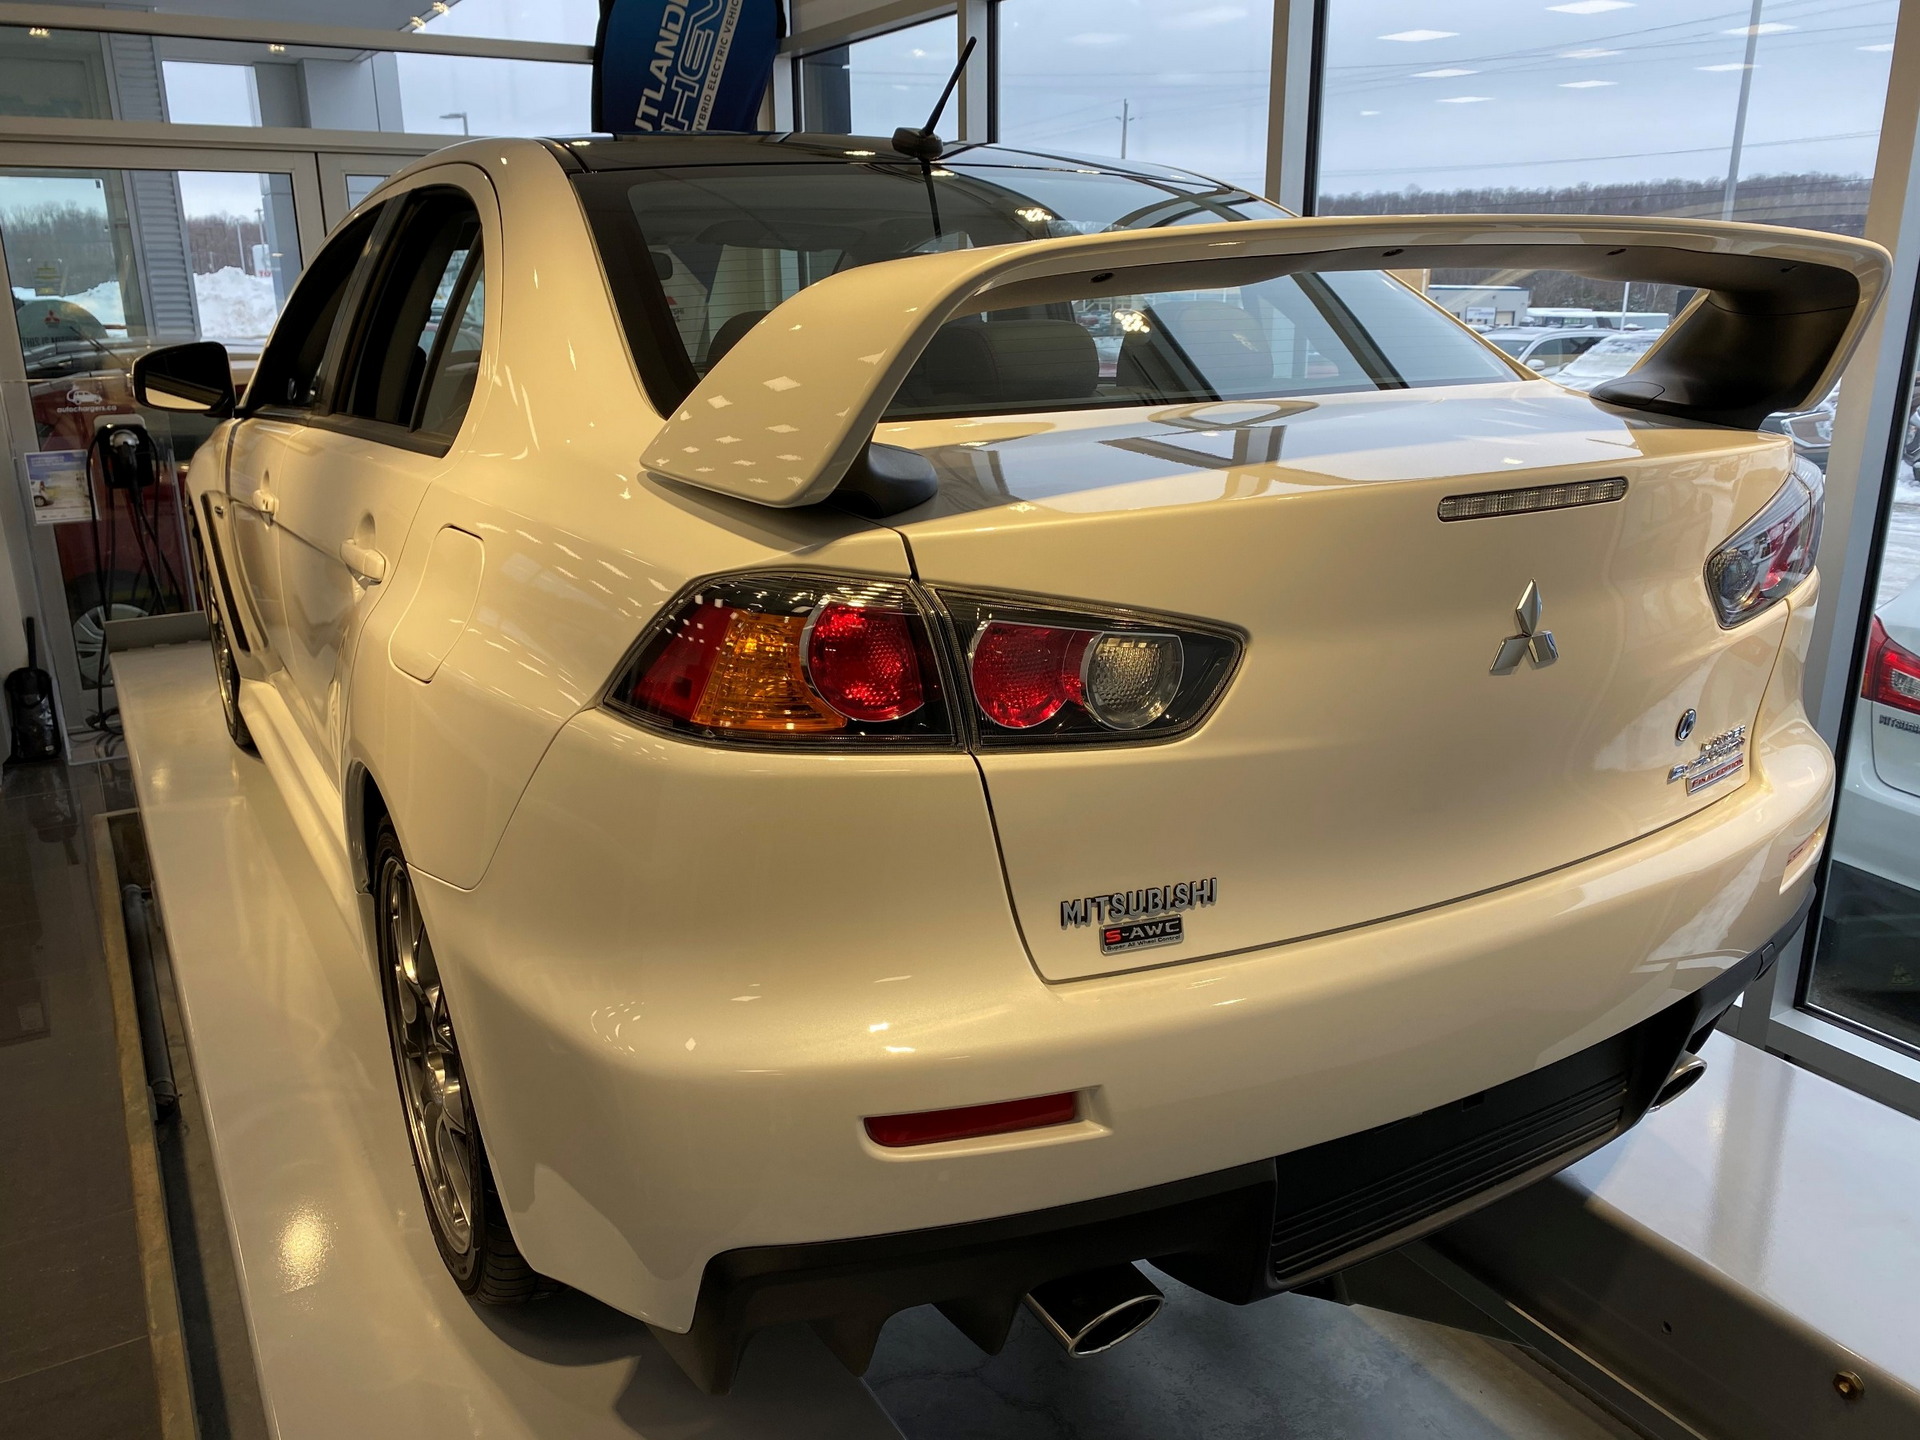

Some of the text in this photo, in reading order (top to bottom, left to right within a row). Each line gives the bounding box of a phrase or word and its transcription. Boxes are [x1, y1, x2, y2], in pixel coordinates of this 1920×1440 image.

[695, 0, 739, 131] YBRID ELECTRIC VEHIC
[1060, 878, 1217, 928] MITSUBISHI
[1105, 920, 1180, 943] S-AWC
